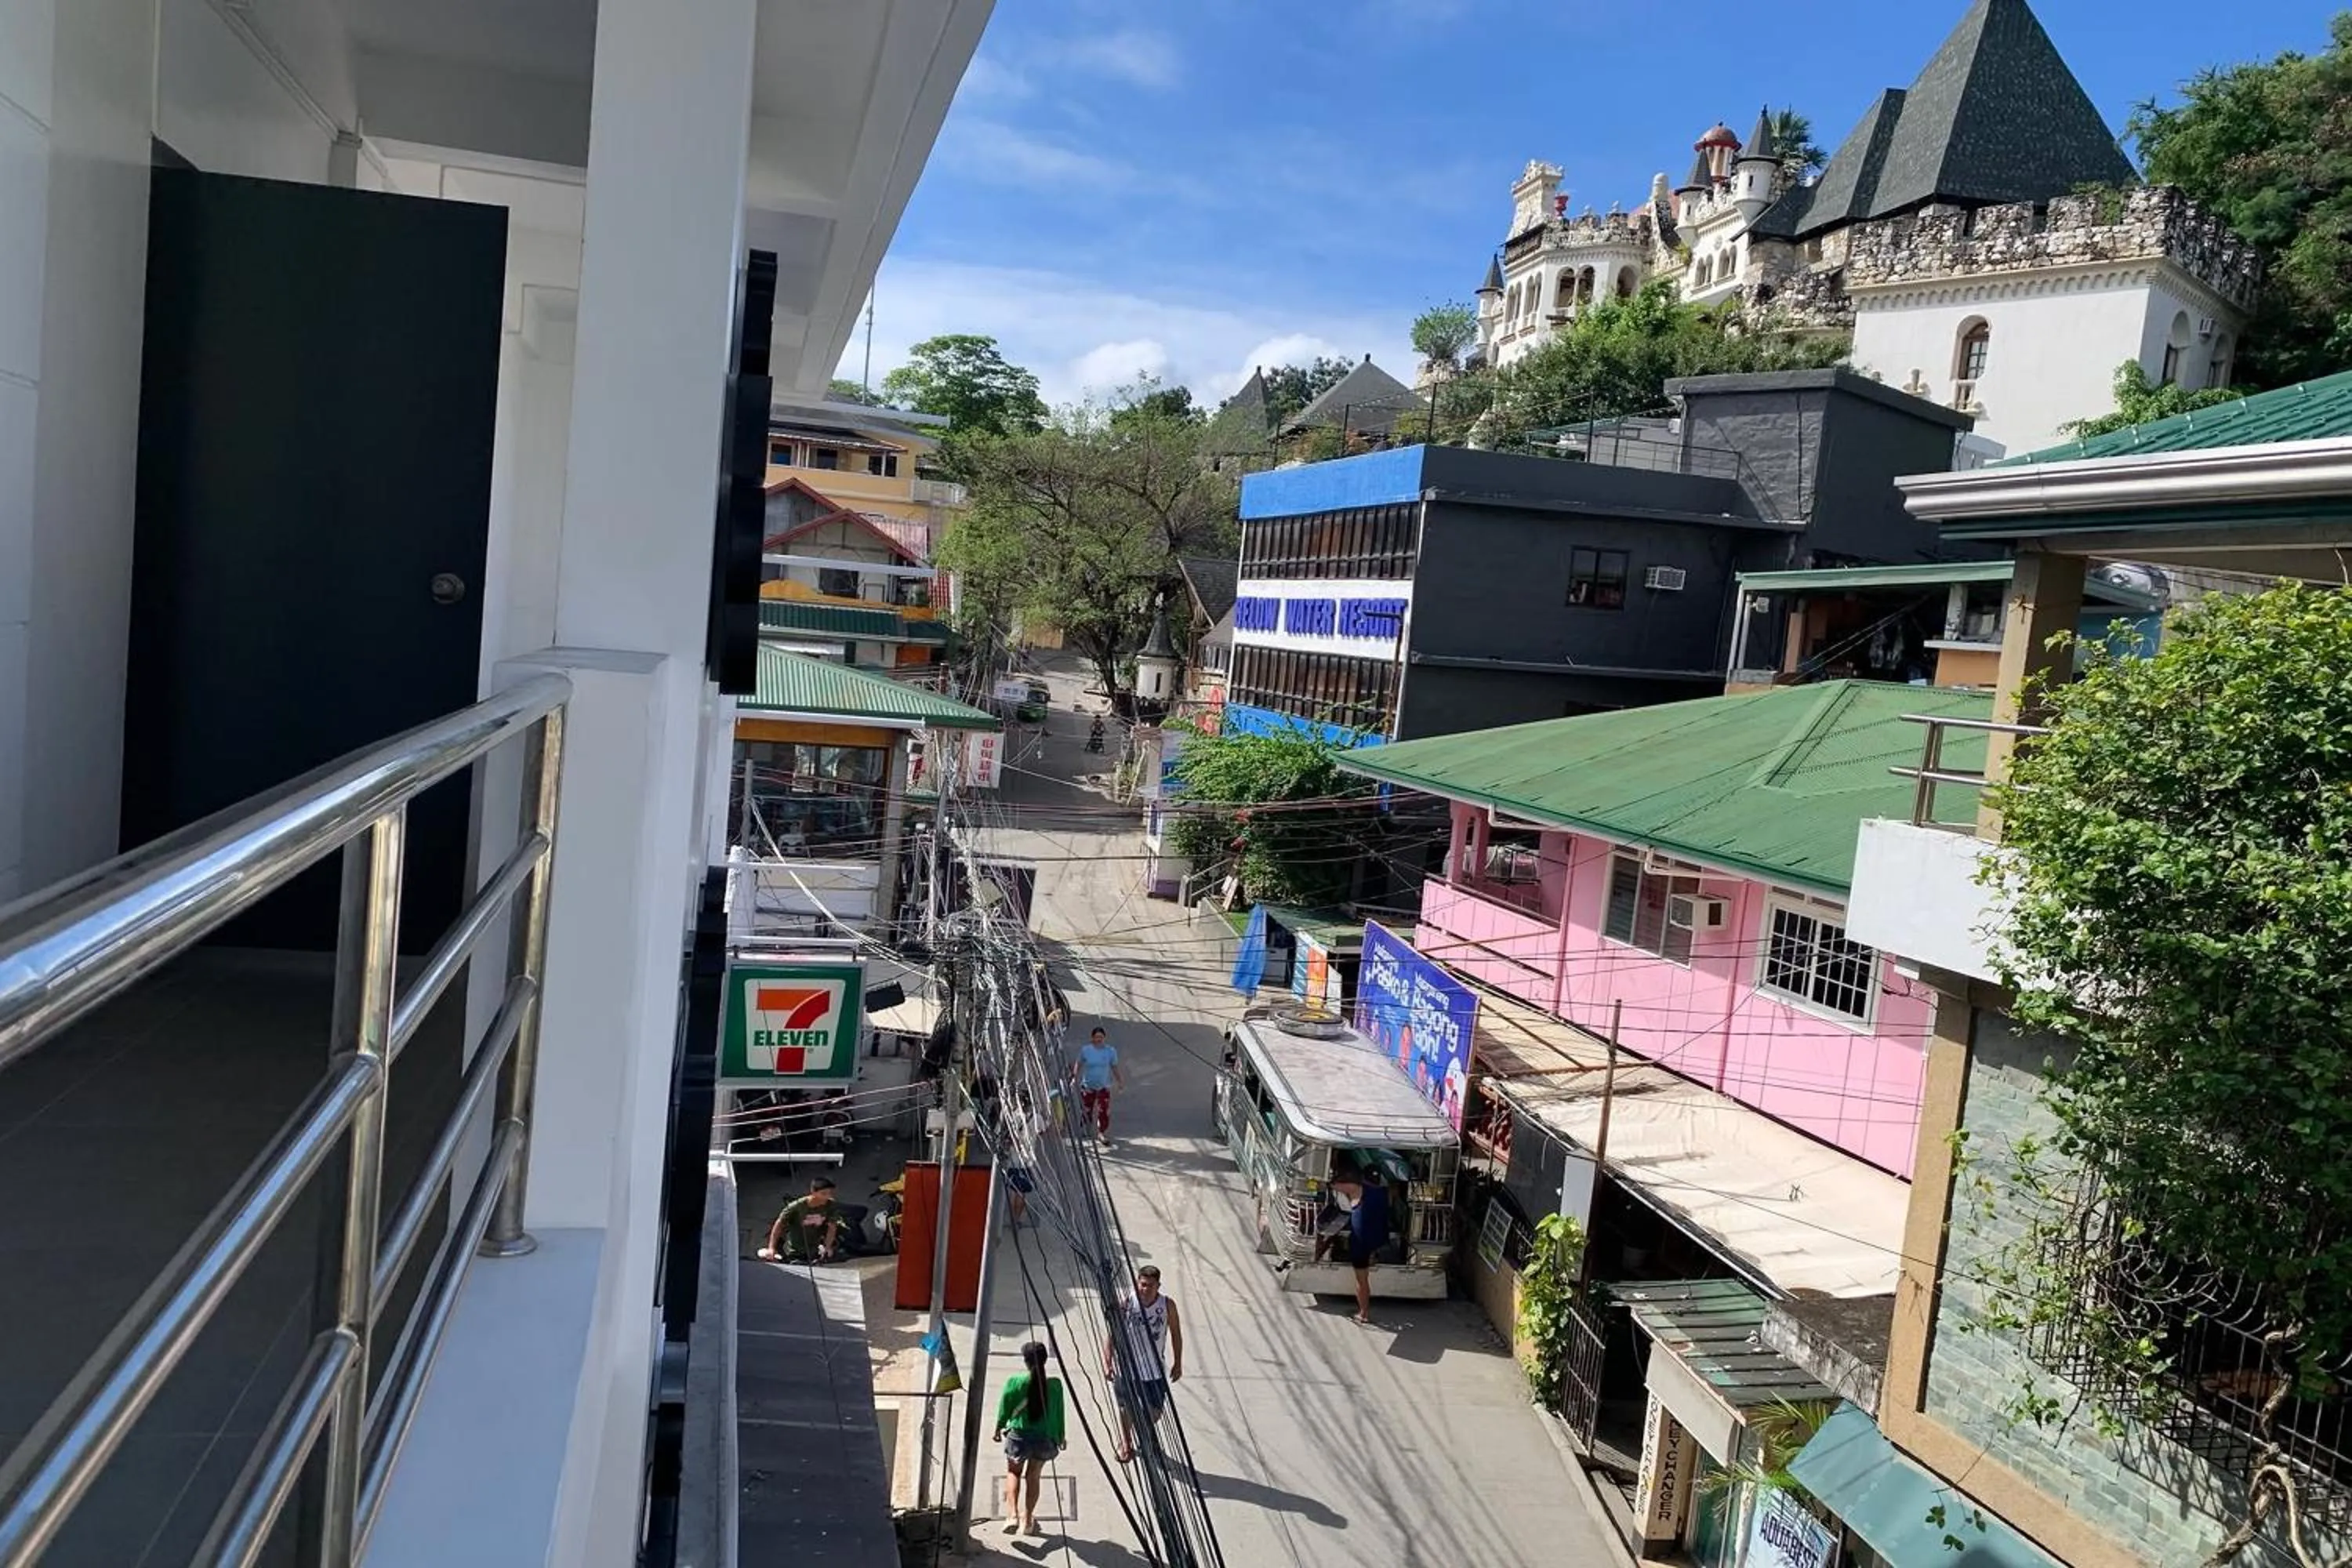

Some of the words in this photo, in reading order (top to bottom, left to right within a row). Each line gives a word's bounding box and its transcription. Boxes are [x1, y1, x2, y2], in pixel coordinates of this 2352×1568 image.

[1285, 599, 1335, 637] WATER
[1338, 599, 1408, 641] RESORT
[757, 988, 831, 1073] 7
[1668, 1417, 1682, 1449] NEY
[1658, 1450, 1678, 1521] CHANGER
